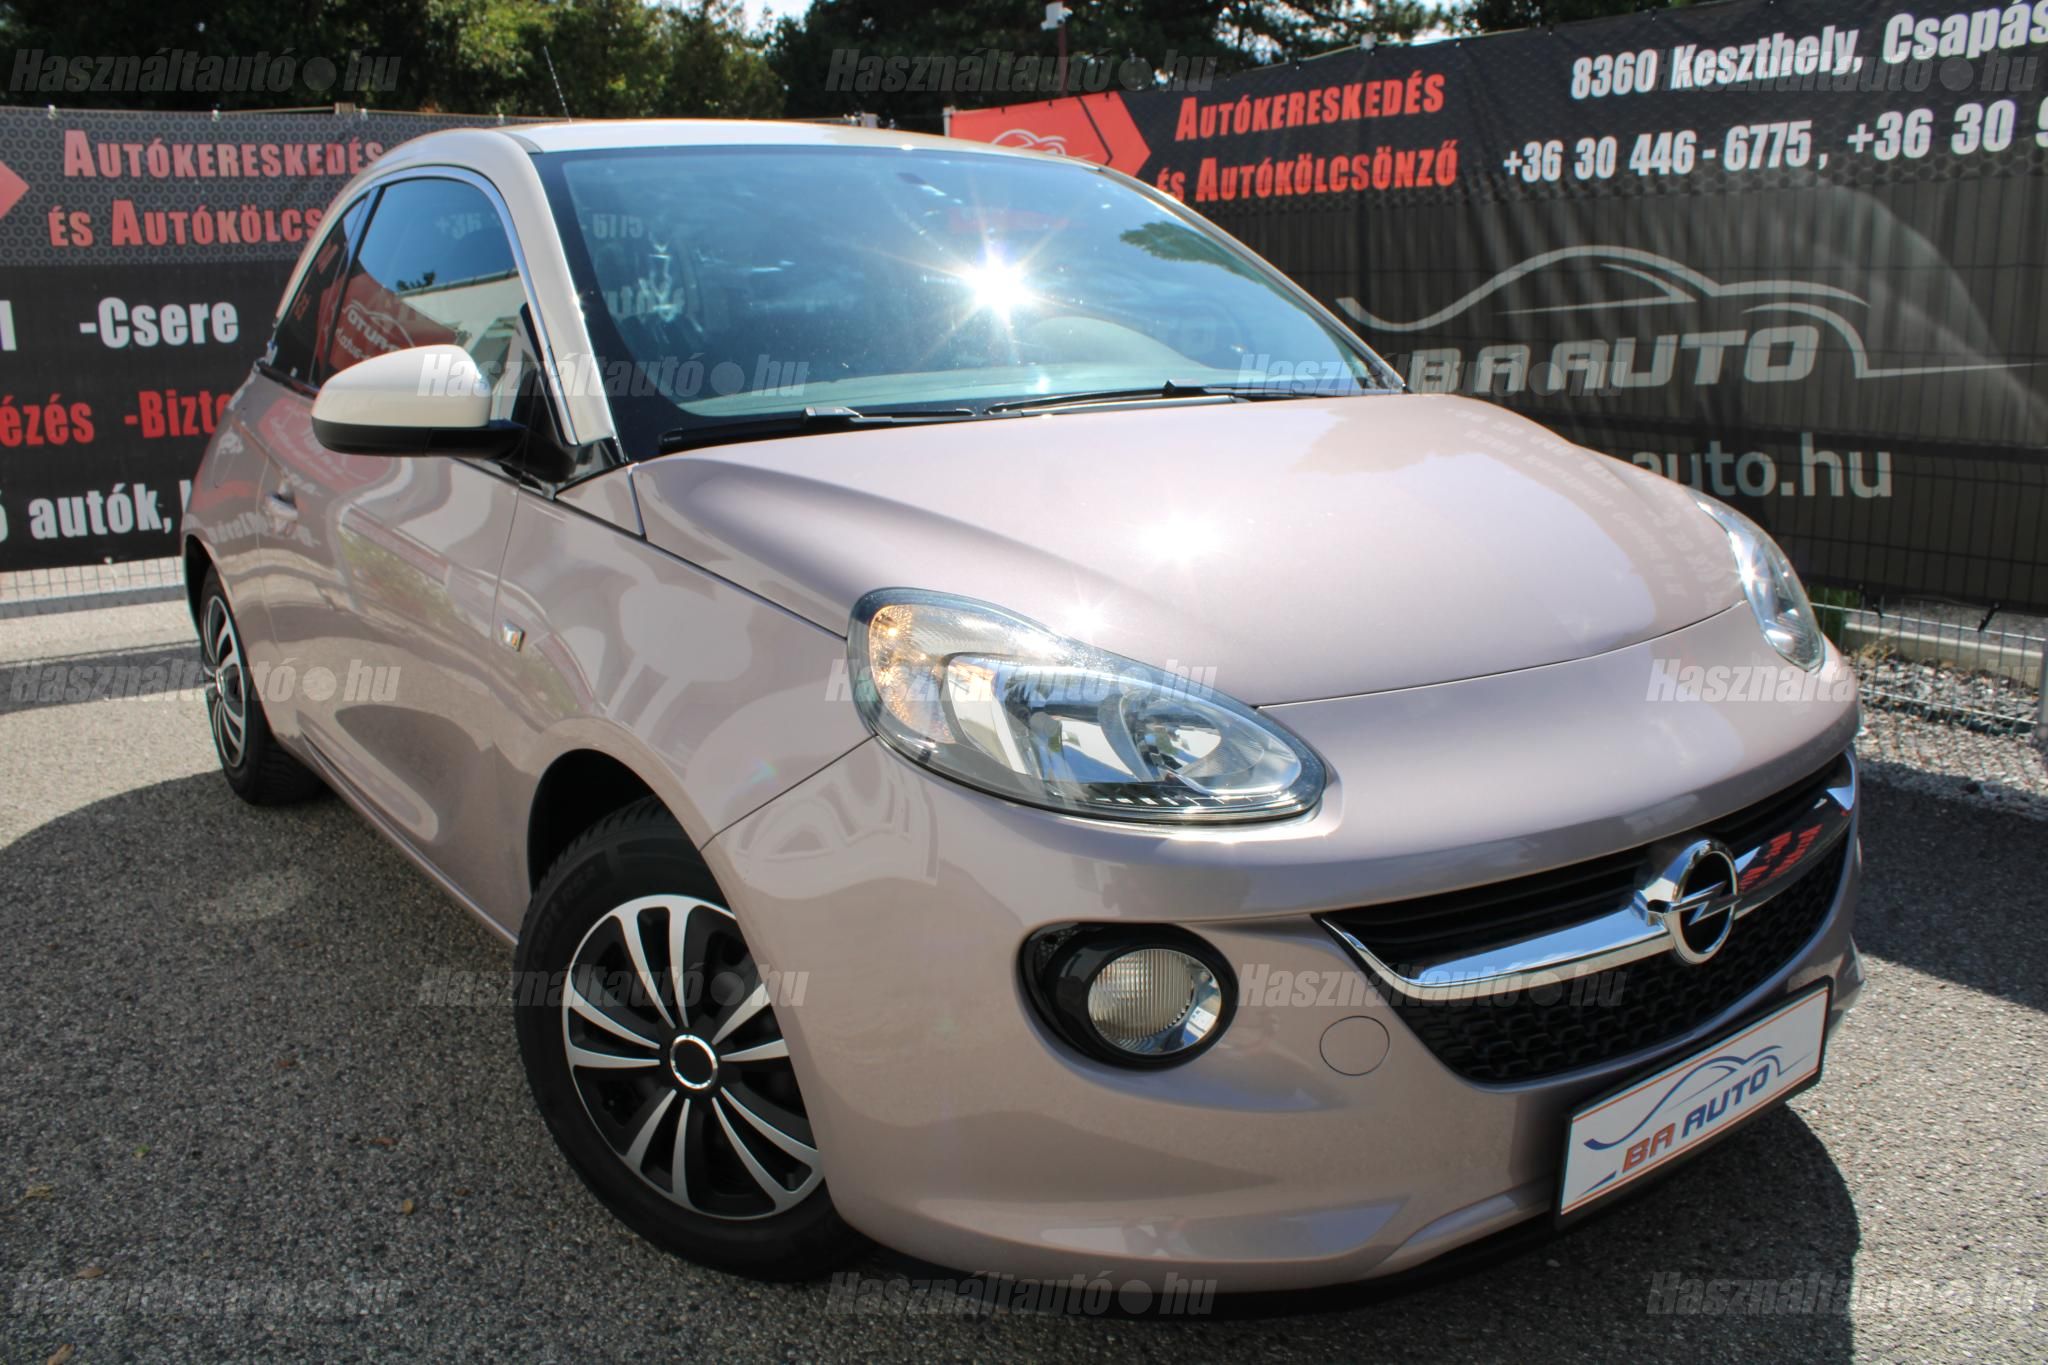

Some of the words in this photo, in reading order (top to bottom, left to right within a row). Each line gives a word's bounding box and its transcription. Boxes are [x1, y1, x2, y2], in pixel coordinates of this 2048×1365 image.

[1571, 49, 1657, 100] 8360
[1670, 25, 1863, 90] Keszthely,
[1174, 70, 1446, 142] AUTÓKERESKEDÉS
[1196, 139, 1458, 202] AUTÓKÖLCSÖNZŐ
[1503, 140, 1563, 183] +36
[1574, 136, 1617, 180] 30
[1847, 108, 1933, 161] +36
[1951, 99, 2016, 155] 30
[48, 205, 94, 247] ÉS
[79, 296, 239, 349] -Csere
[1546, 325, 1820, 391] AUTO
[28, 483, 173, 540] autók,
[1622, 1123, 1676, 1174] BA
[1681, 1064, 1770, 1138] AUTO
